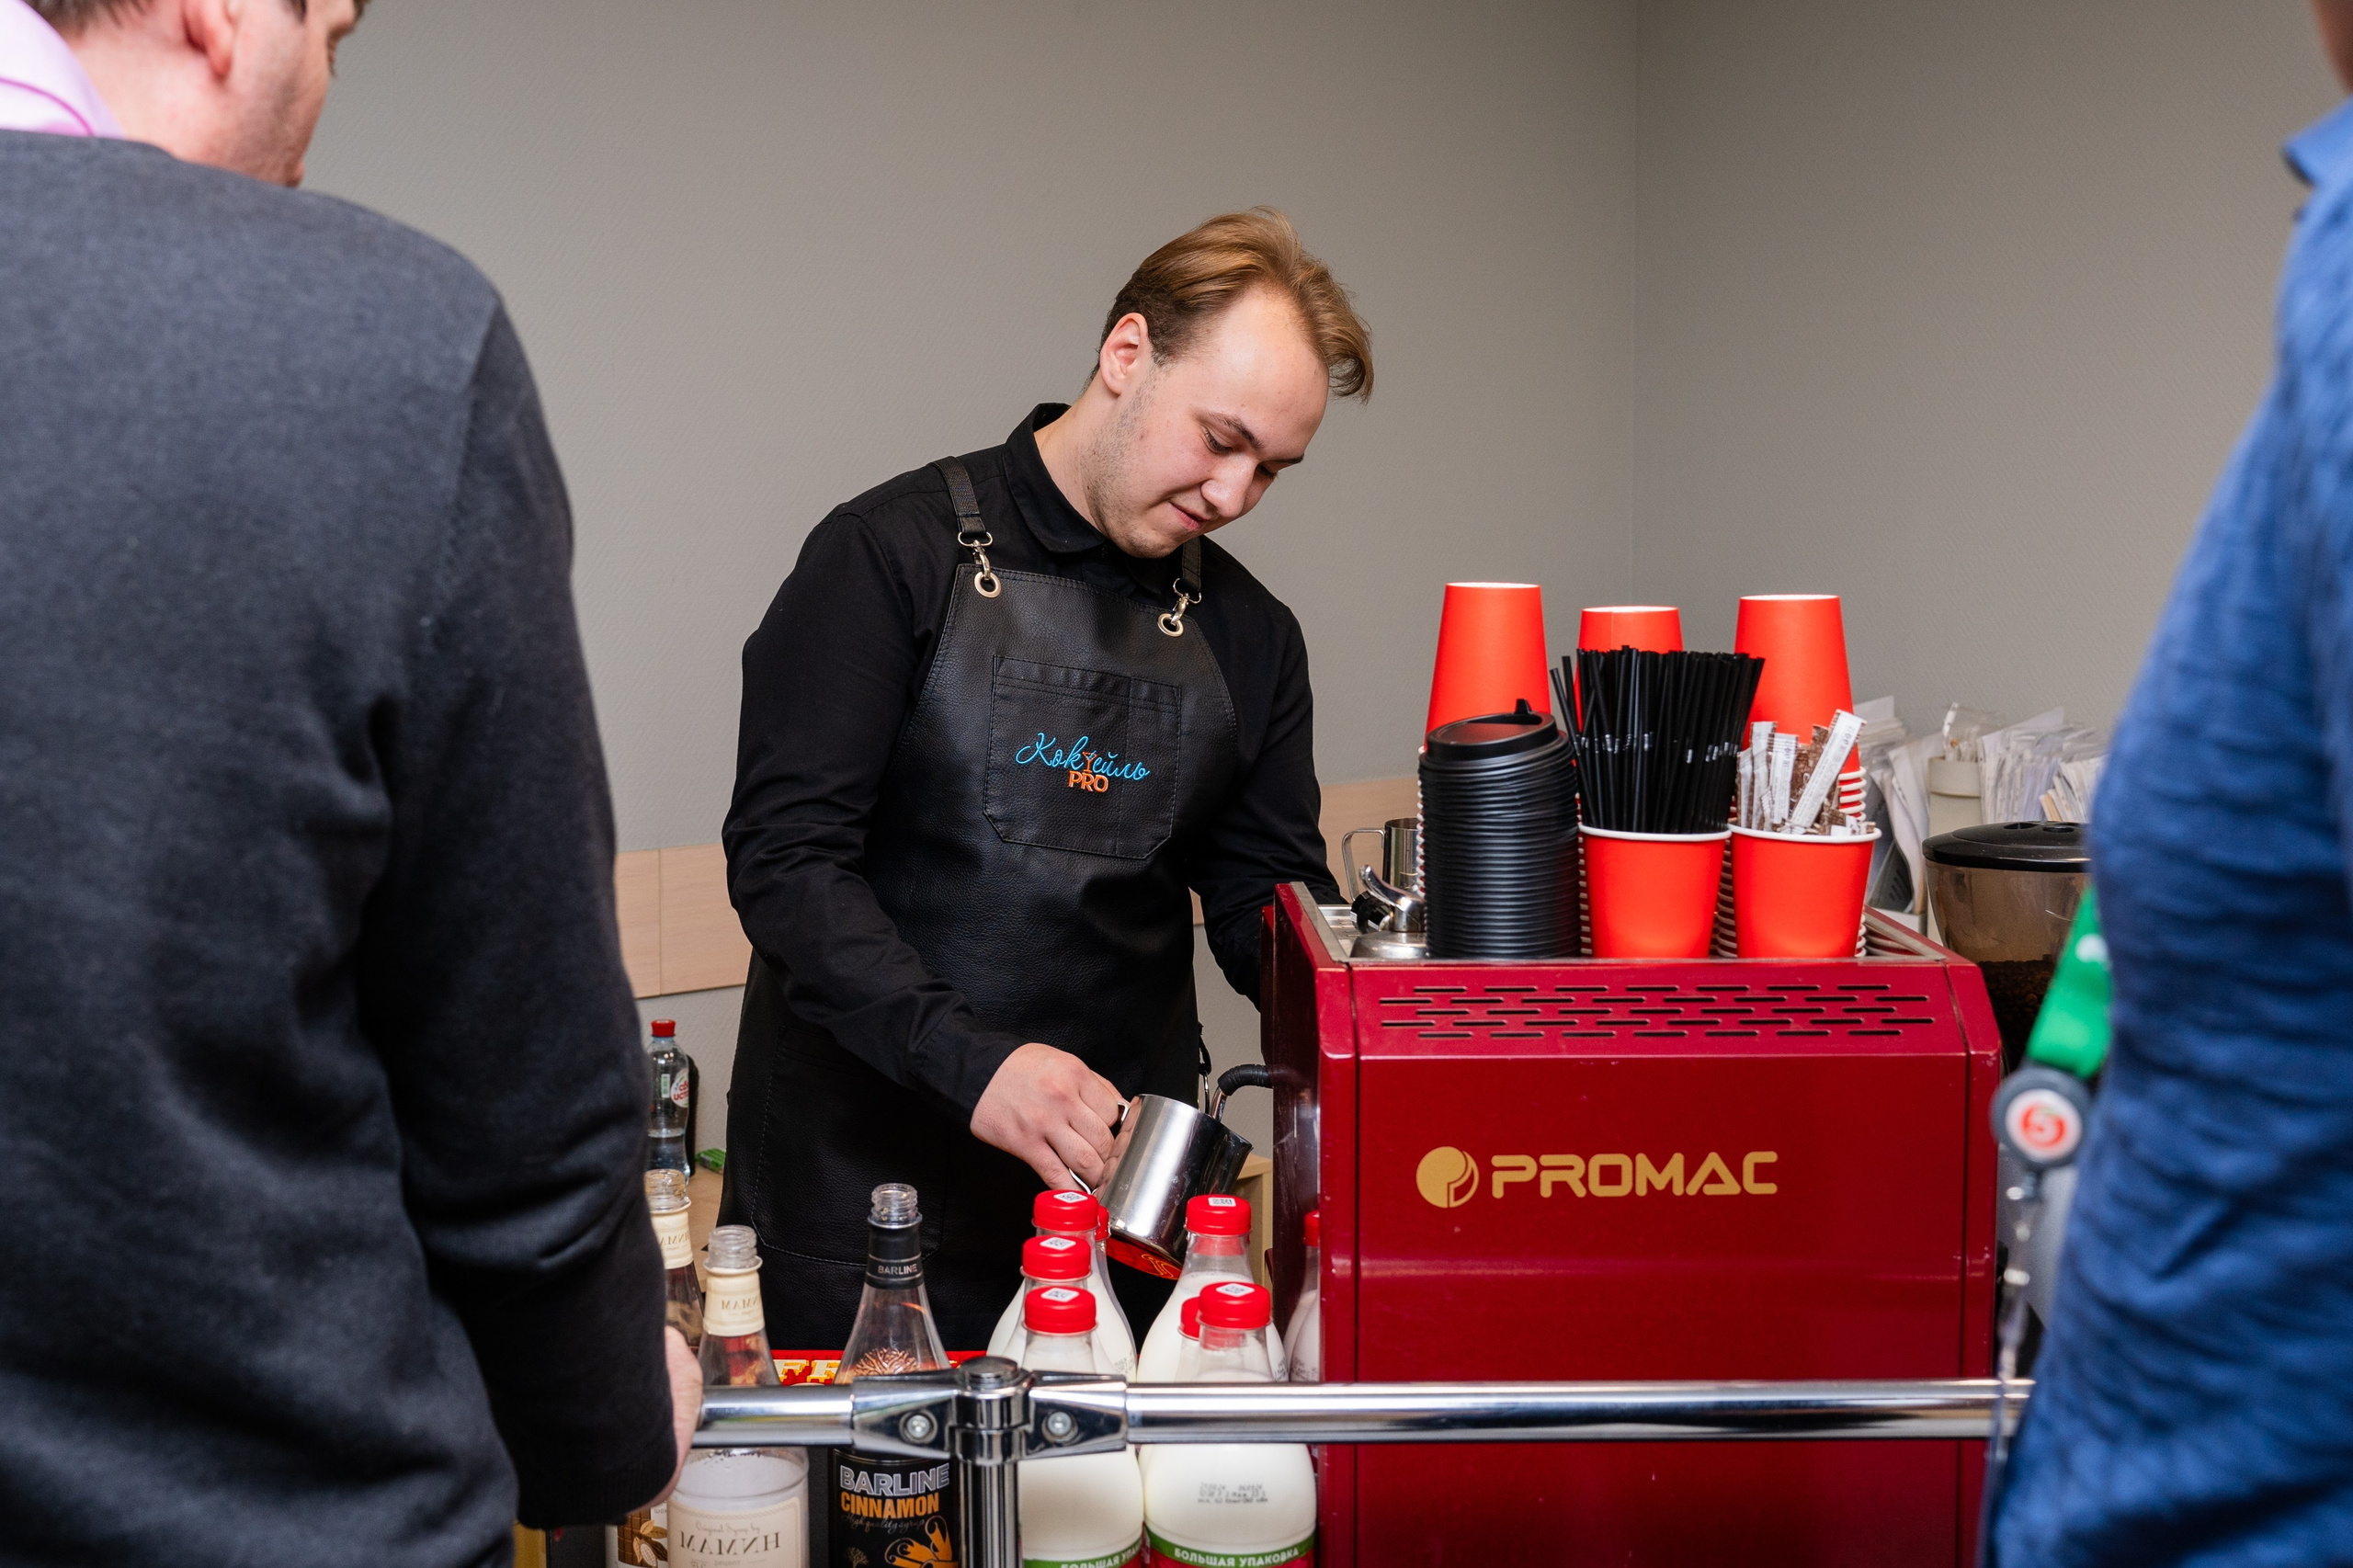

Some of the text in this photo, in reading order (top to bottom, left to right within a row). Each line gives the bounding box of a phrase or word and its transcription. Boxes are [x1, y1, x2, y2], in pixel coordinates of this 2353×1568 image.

[1068, 769, 1109, 793] PRO
[1491, 1151, 1779, 1199] PROMAC
[878, 1263, 918, 1276] BARLINE
[839, 1462, 950, 1497] BARLINE
[840, 1491, 940, 1519] CINNAMON
[1174, 1547, 1299, 1568] БОЛЬШАЯ УПАКОВКА
